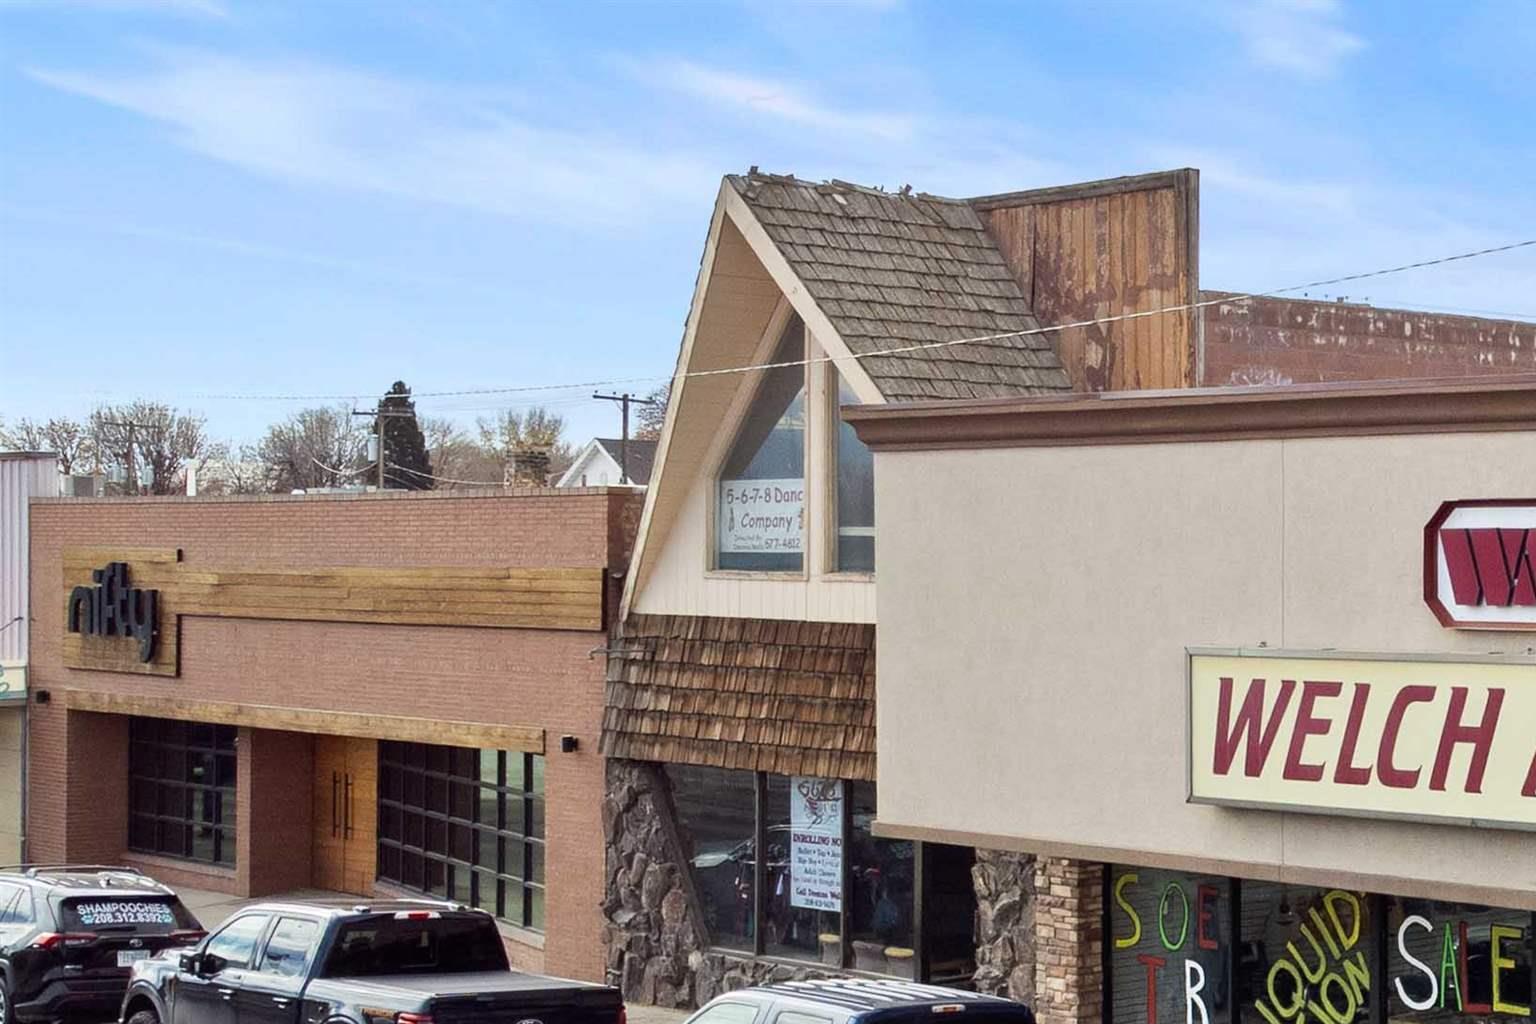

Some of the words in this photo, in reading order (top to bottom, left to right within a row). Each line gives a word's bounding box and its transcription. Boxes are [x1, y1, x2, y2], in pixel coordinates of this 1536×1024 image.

[740, 512, 793, 533] Company
[68, 562, 160, 663] nifty
[1211, 677, 1506, 795] WELCH
[76, 902, 171, 915] SHAMPOOCHIES
[1394, 914, 1531, 1016] SALE
